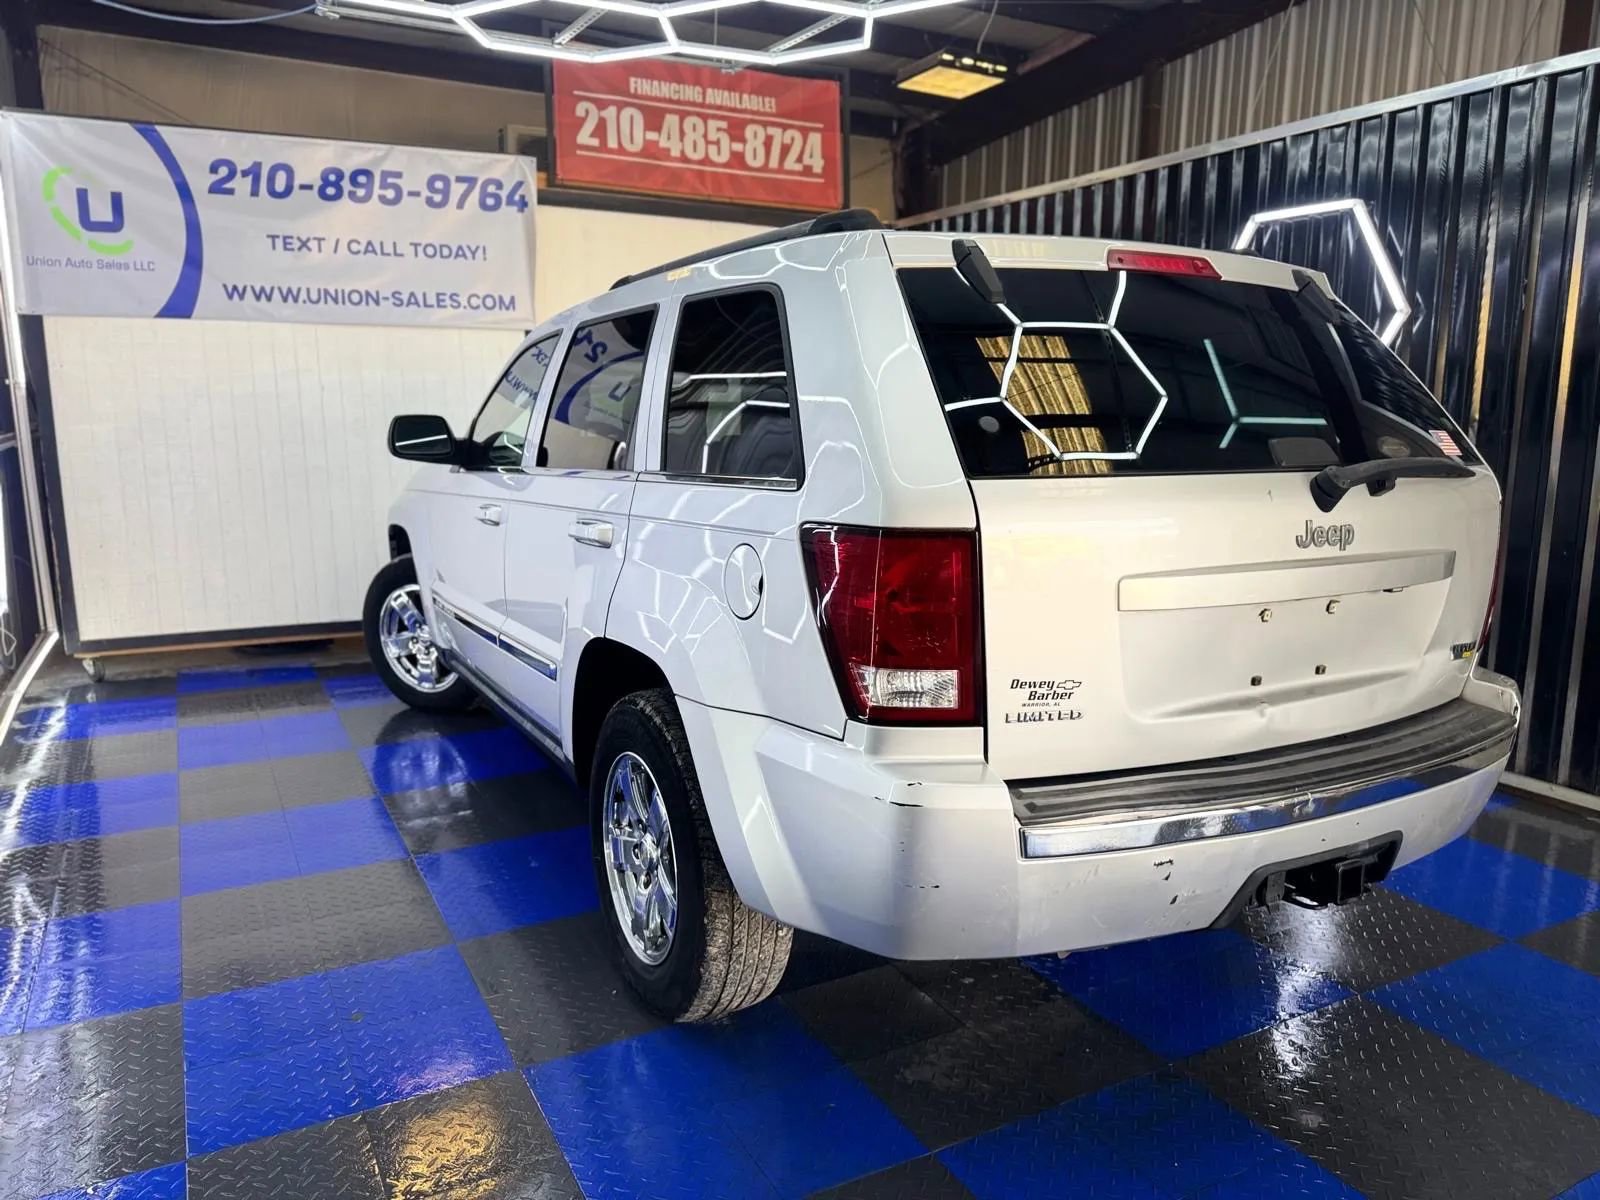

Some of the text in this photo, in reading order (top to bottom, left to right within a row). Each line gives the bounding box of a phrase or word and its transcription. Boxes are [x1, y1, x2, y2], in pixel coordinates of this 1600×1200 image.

[629, 77, 777, 113] FINANCING AVAILABLE!
[574, 101, 825, 174] 210-485-8724
[207, 158, 529, 213] 210-895-9764
[266, 234, 487, 261] TEXT / CALL TODAY!
[26, 255, 156, 272] Union Auto Sales LLC
[222, 283, 516, 311] WWW.UNION-SALES.COM
[1295, 519, 1355, 551] Jeep
[1010, 679, 1055, 691] Dewey
[1028, 690, 1075, 701] Barber
[1005, 709, 1083, 724] LIMITED
